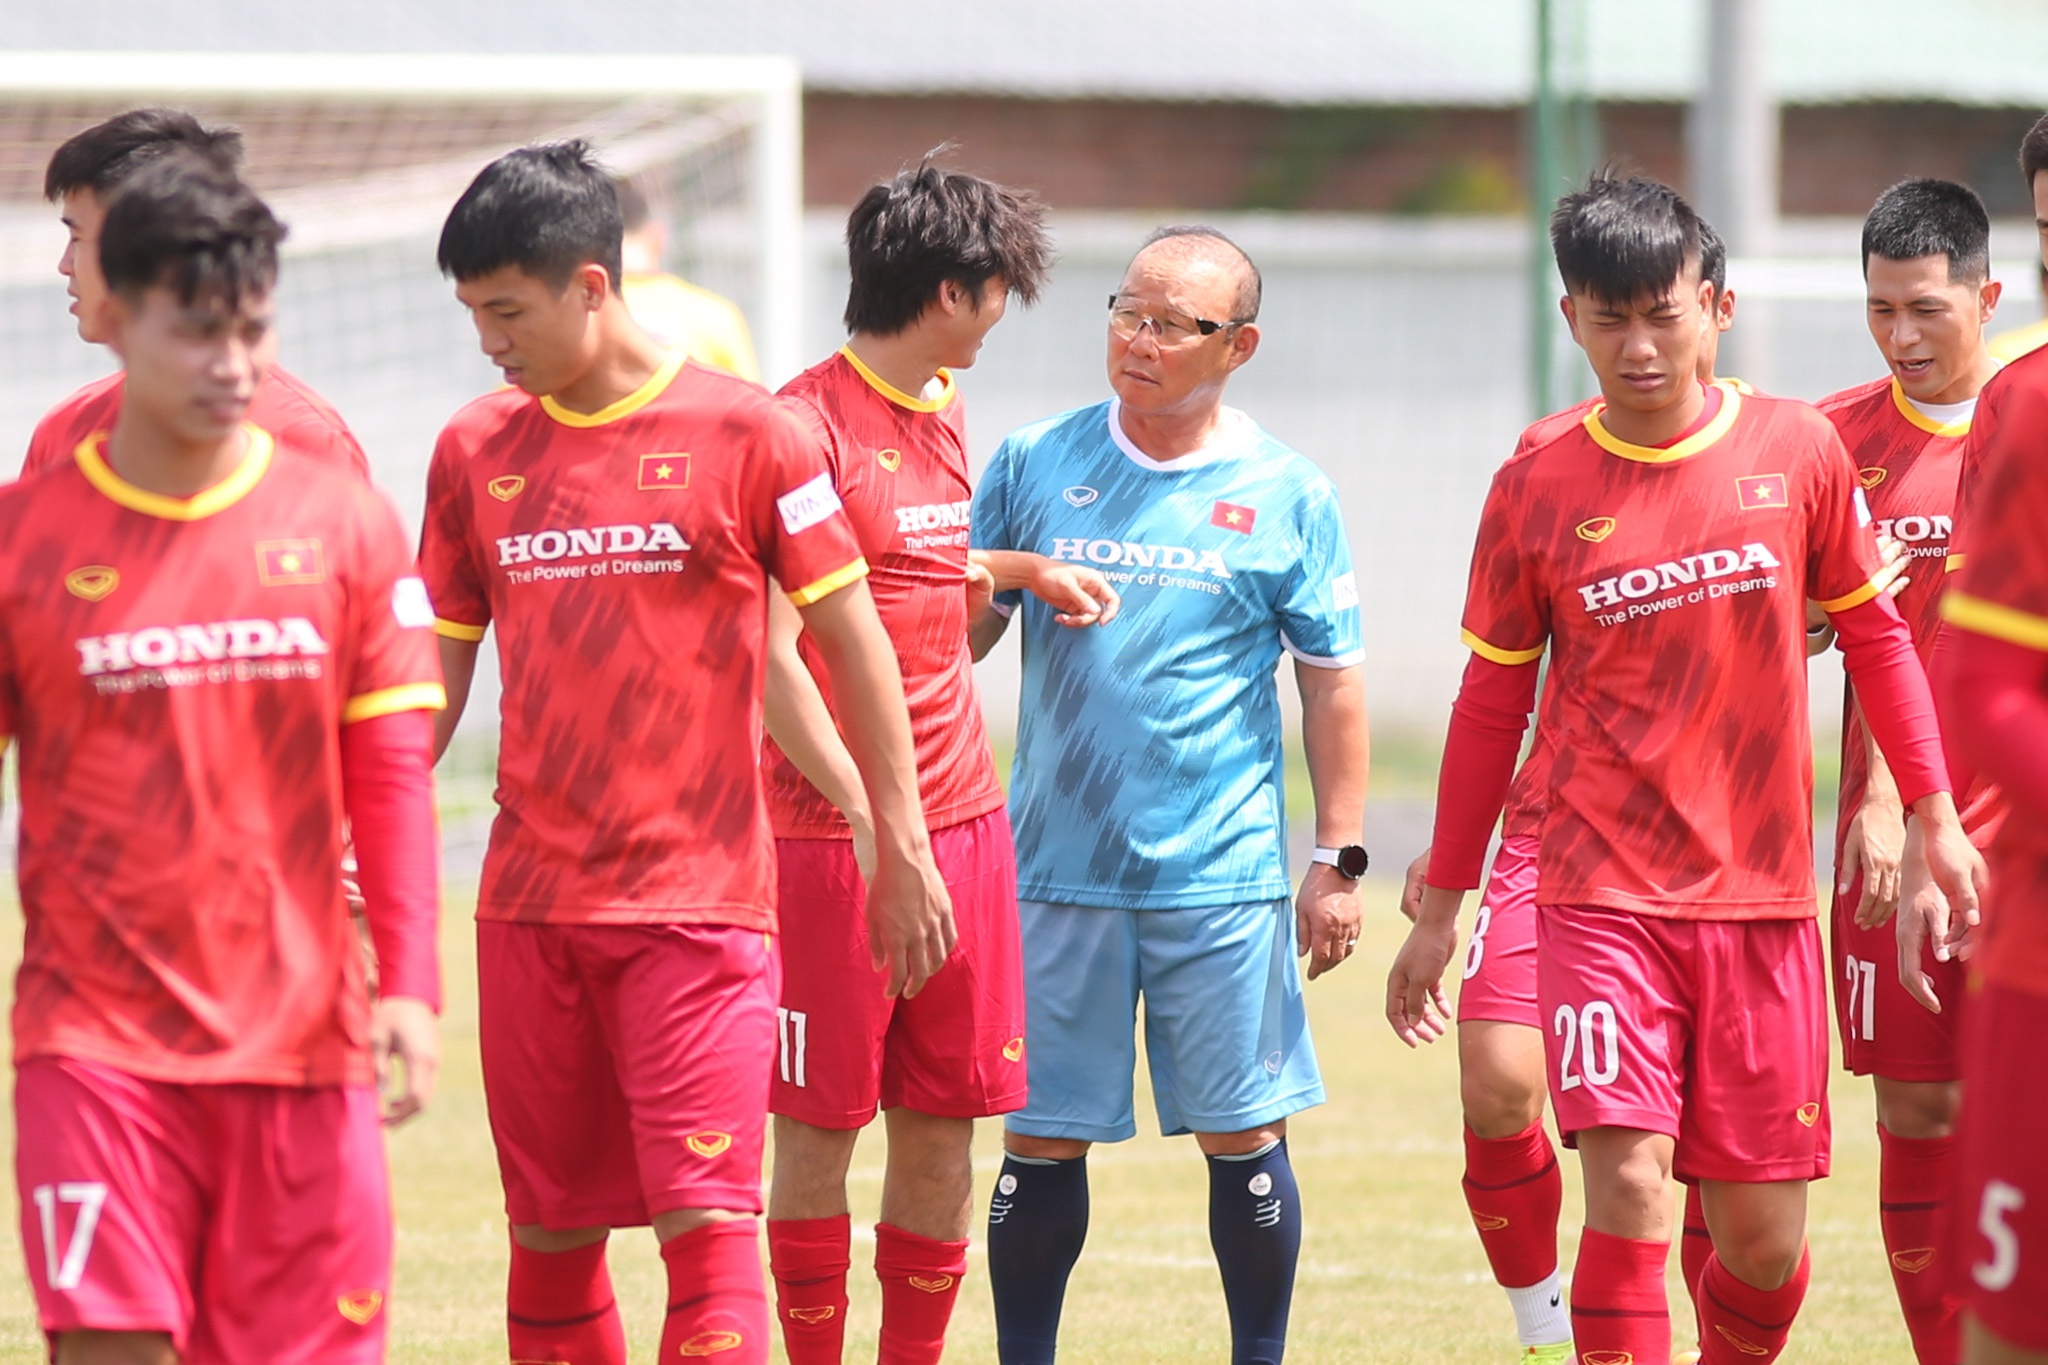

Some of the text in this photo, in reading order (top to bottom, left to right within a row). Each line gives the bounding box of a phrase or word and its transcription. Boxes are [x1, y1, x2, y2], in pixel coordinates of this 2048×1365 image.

[496, 523, 691, 566] HONDA
[904, 537, 923, 549] The
[923, 535, 953, 547] Power
[1050, 538, 1232, 579] HONDA
[506, 558, 684, 585] The Power of Dreams
[1137, 572, 1156, 586] of
[1158, 573, 1222, 596] Dreams
[1578, 542, 1780, 612] HONDA
[1595, 575, 1777, 628] The Power of Dreams
[75, 617, 330, 675] HONDA
[1845, 954, 1876, 1041] 21
[775, 1007, 807, 1088] 11
[1554, 1000, 1620, 1091] 20
[33, 1181, 108, 1290] 17
[1970, 1179, 2026, 1292] 5
